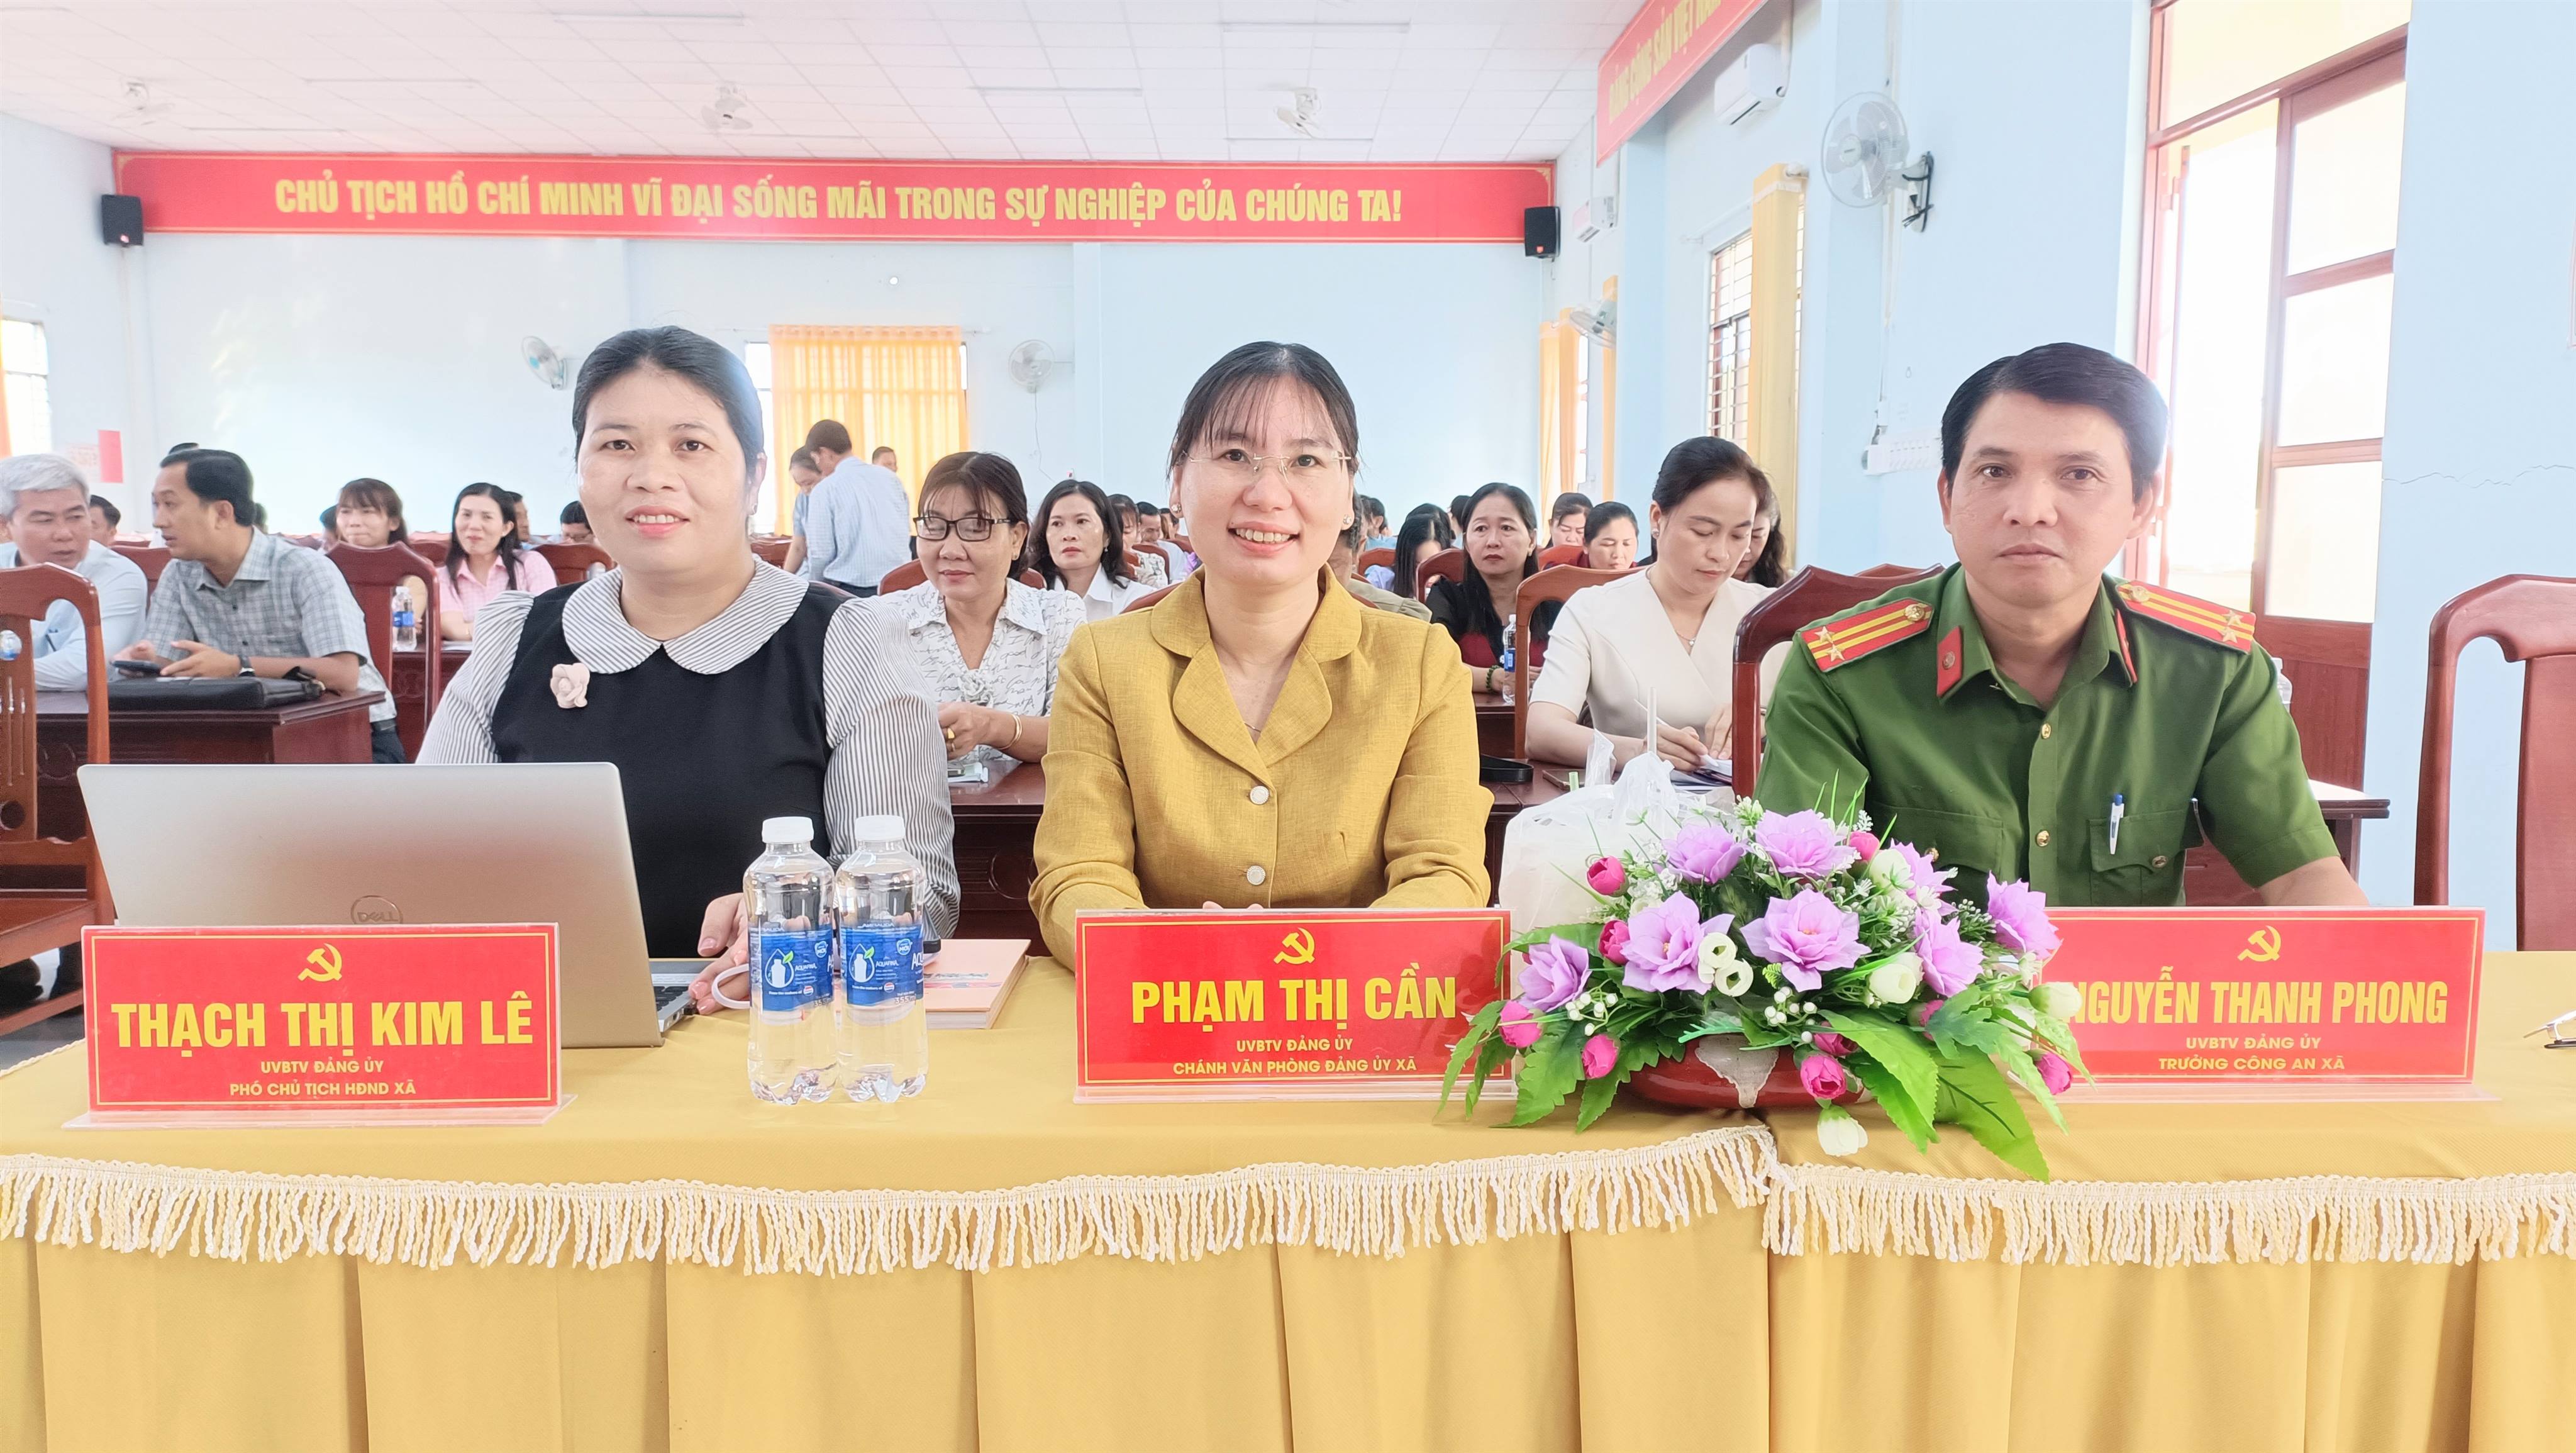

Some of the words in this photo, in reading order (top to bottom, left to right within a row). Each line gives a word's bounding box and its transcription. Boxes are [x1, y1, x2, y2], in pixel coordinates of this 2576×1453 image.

[275, 170, 338, 213] CHỦ
[347, 179, 417, 220] TỊCH
[425, 170, 469, 214] HỒ
[477, 175, 530, 214] CHÍ
[540, 182, 624, 216] MINH
[631, 178, 662, 216] VĨ
[670, 184, 723, 223] ĐẠI
[733, 174, 818, 218] SỐNG
[827, 180, 886, 219] MÃI
[895, 187, 996, 220] TRONG
[1005, 185, 1049, 227] SỰ
[1055, 182, 1167, 227] NGHIỆP
[1176, 178, 1237, 221] CỦA
[1246, 182, 1349, 222] CHÚNG
[1357, 189, 1402, 222] TA!
[357, 911, 399, 922] DELL
[1132, 980, 1264, 1032] PHẠM
[1279, 979, 1348, 1030] THỊ
[1364, 962, 1456, 1020] CẦN
[2210, 981, 2322, 1024] THANH
[2332, 981, 2448, 1024] PHONG
[111, 1003, 265, 1057] THẠCH
[280, 1003, 354, 1057] THỊ
[372, 1001, 463, 1046] KIM
[480, 991, 533, 1044] LÊ
[1236, 1040, 1282, 1052] UVBTV
[1286, 1035, 1331, 1051] ĐẢNG
[1335, 1034, 1353, 1050] ỦY
[2185, 1037, 2239, 1049] UVBTV
[2243, 1033, 2295, 1049] ĐẢNG
[2299, 1033, 2321, 1049] ỦY
[260, 1061, 309, 1073] UVBTV
[314, 1056, 360, 1073] ĐẢNG
[364, 1056, 384, 1072] ỦY
[1173, 1059, 1227, 1074] CHÁNH
[1231, 1059, 1262, 1074] VĂN
[1267, 1059, 1321, 1073] PHÒNG
[1324, 1056, 1368, 1072] ĐẢNG
[1372, 1055, 1392, 1071] ỦY
[1396, 1056, 1417, 1071] XÃ
[2158, 1054, 2228, 1070] TRƯỞNG
[2233, 1055, 2287, 1070] CÔNG
[2291, 1058, 2316, 1069] AN
[2321, 1055, 2345, 1069] XÃ
[230, 1081, 263, 1096] PHÓ
[267, 1079, 301, 1096] CHỦ
[304, 1083, 340, 1098] TỊCH
[345, 1082, 389, 1094] HĐND
[394, 1079, 416, 1094] XÃ
